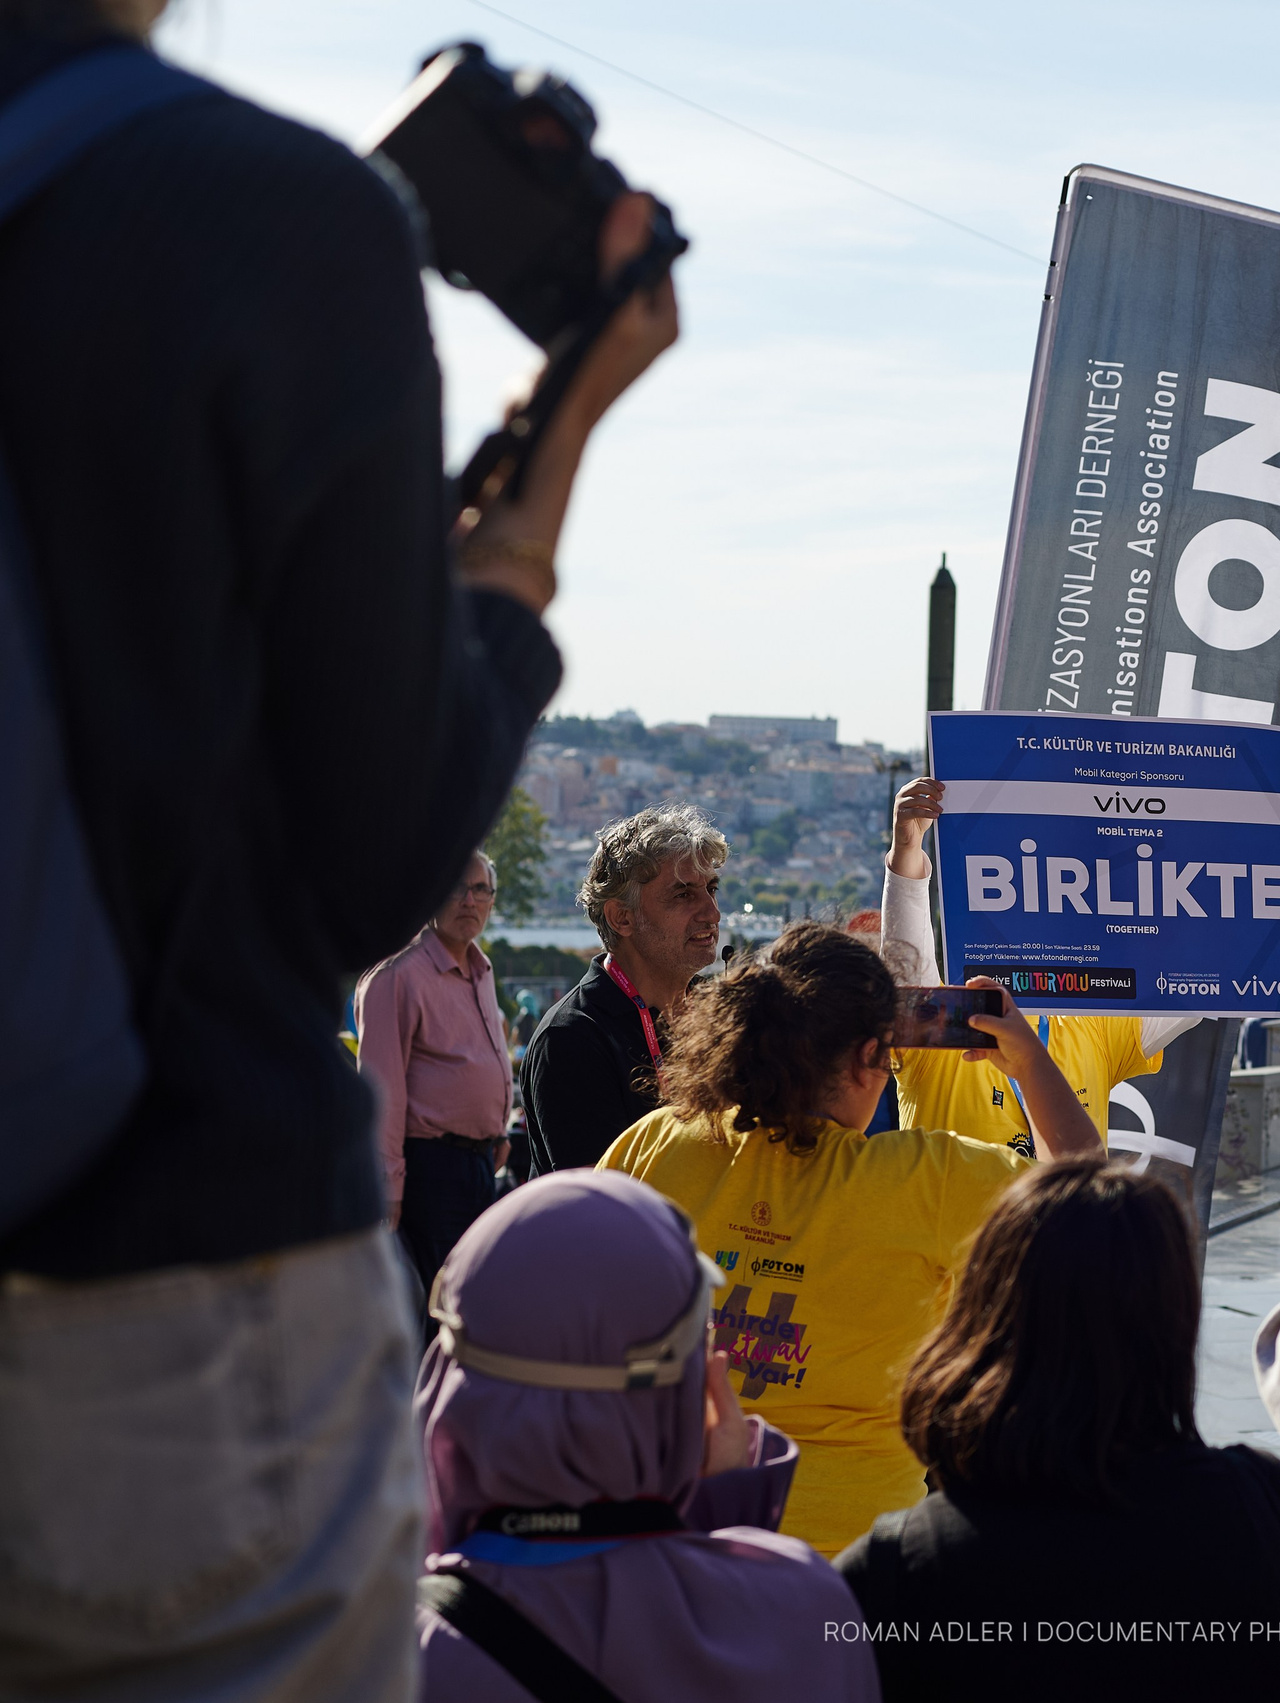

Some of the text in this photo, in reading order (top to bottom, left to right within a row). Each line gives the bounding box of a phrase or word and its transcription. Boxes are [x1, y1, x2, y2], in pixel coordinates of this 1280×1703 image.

[1077, 358, 1125, 498] DERNEĞİ
[1106, 370, 1179, 716] nisations Association
[1017, 736, 1236, 759] T.C. KÜLTÜR VE TURİZM BAKANLIĞI
[1074, 767, 1185, 782] Mobil Kategori Sponsoru
[1093, 791, 1166, 814] vivo
[1097, 826, 1163, 838] MOBİL TEMA 2
[1106, 924, 1159, 936] (TOGETHER)
[964, 953, 993, 961] Fotoğraf
[1022, 953, 1099, 964] www.fotondernegi.com
[1012, 972, 1056, 993] KÜLTÜR
[1057, 972, 1089, 992] YOLU
[1090, 977, 1131, 988] FESTİVALİ
[1169, 983, 1220, 995] FOTON
[762, 1259, 804, 1274] FOTON
[714, 1306, 795, 1340] hirde
[746, 1360, 807, 1388] Var!
[502, 1512, 580, 1532] Canon
